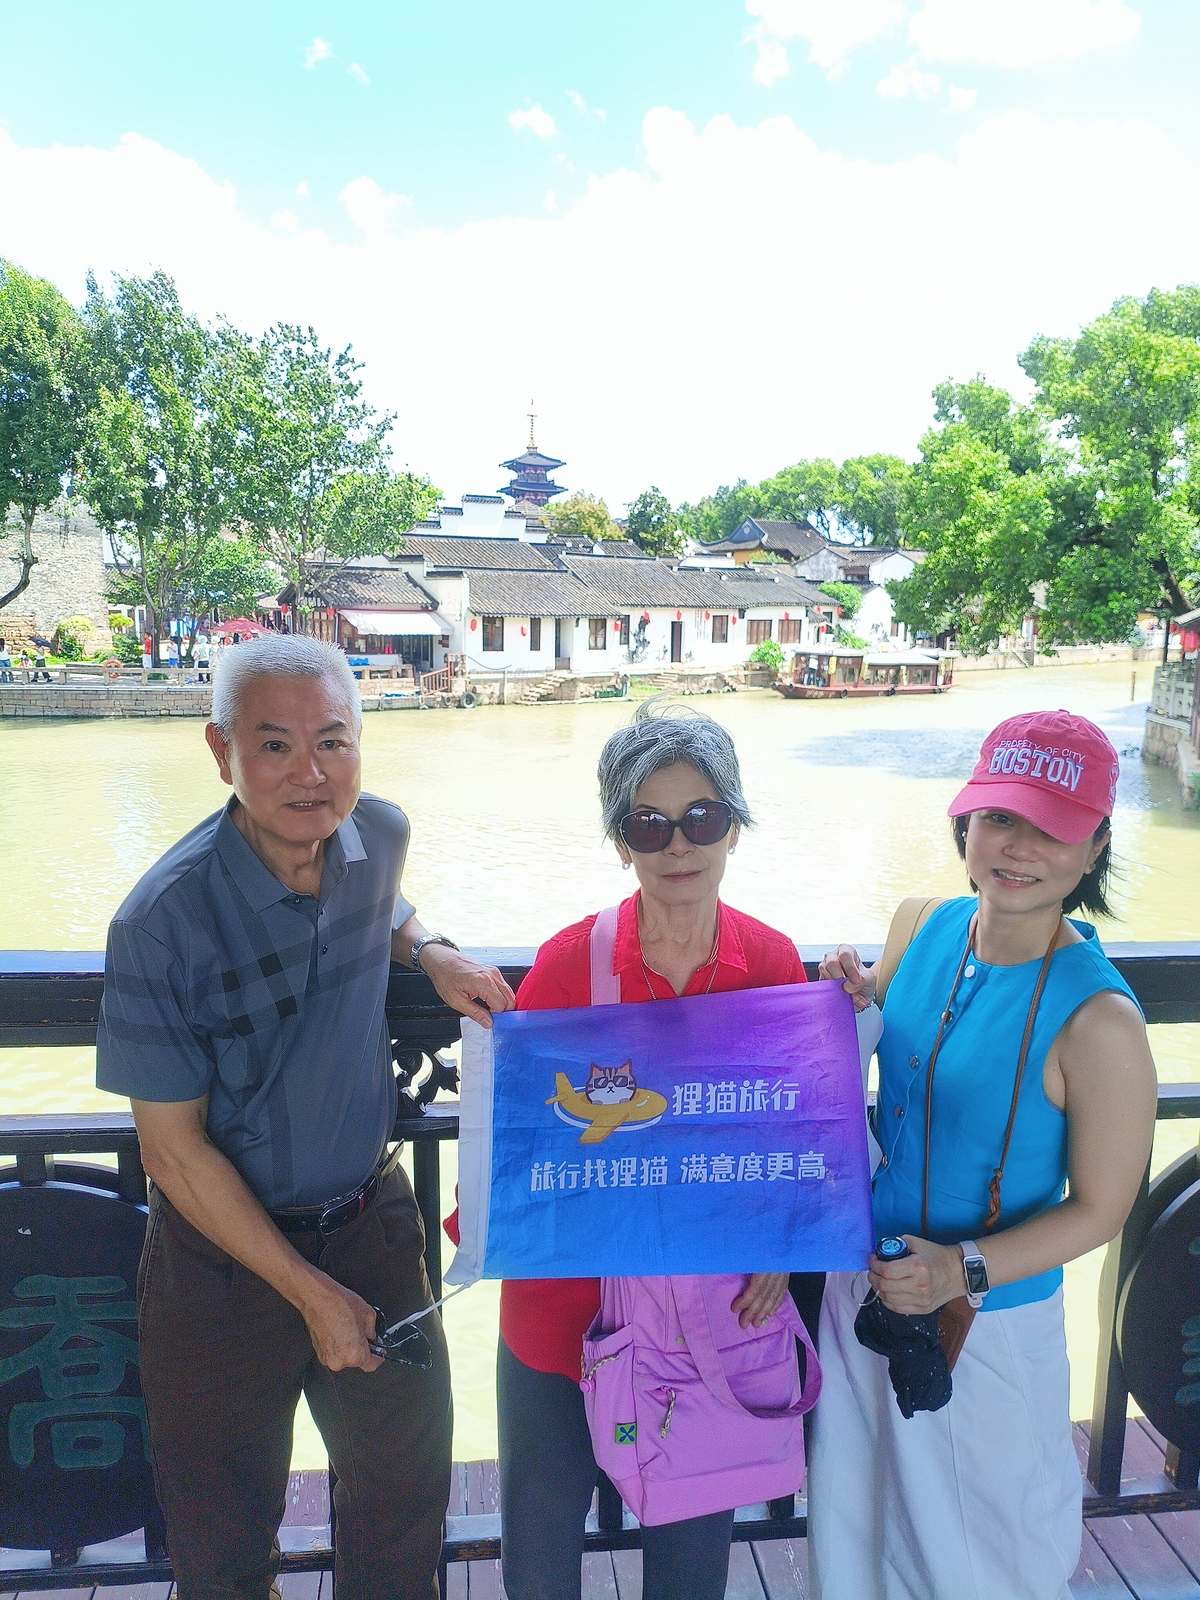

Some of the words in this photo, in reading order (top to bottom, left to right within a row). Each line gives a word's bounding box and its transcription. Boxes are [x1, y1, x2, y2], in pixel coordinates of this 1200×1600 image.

[988, 747, 1084, 792] BOSTON
[1044, 746, 1060, 757] OF
[1061, 748, 1086, 763] CITY
[672, 1079, 801, 1116] 狸猫旅行
[530, 1156, 669, 1192] 旅行找狸猫
[680, 1150, 826, 1184] 满意度更高
